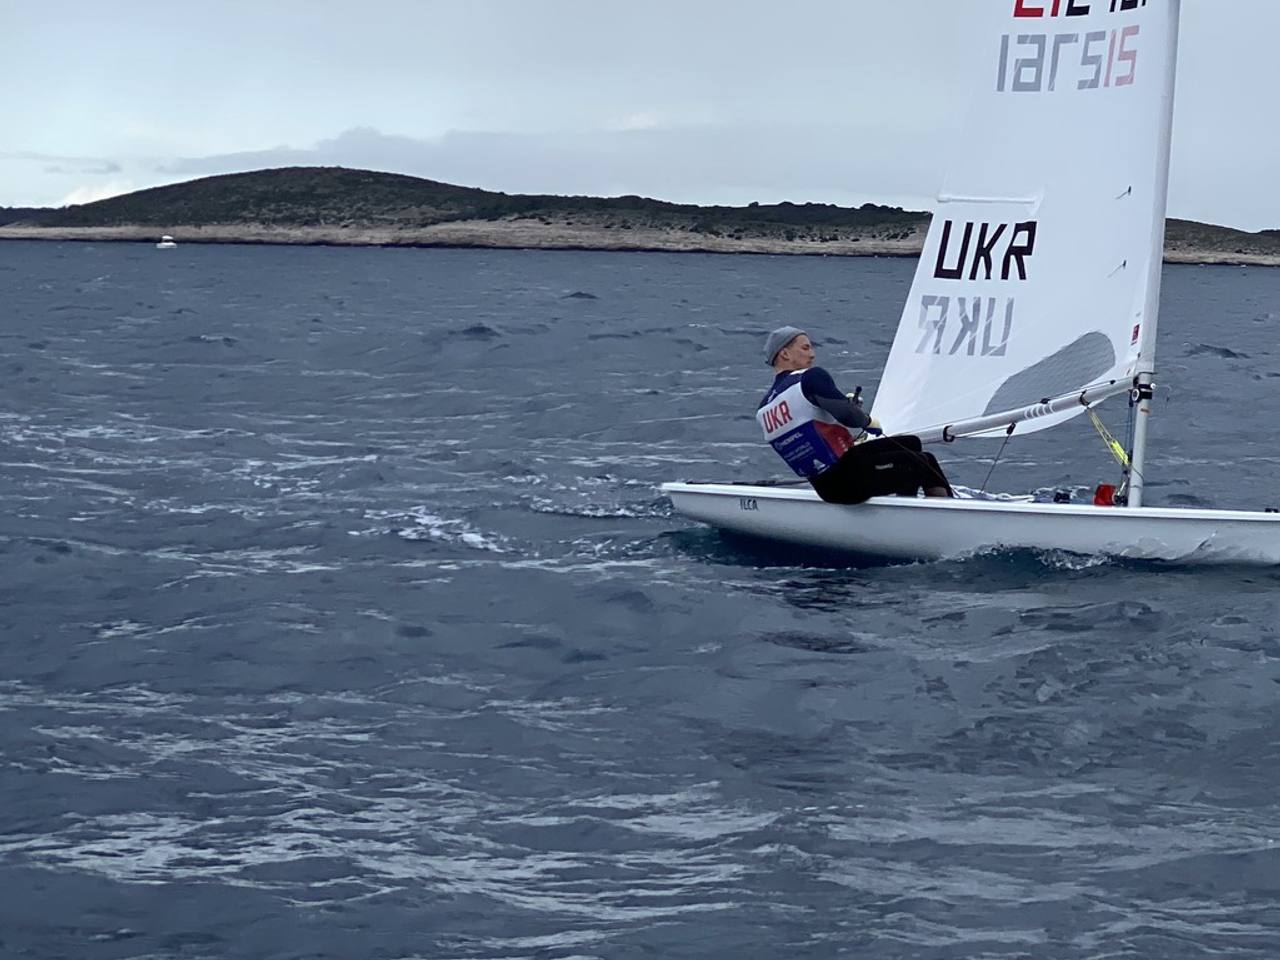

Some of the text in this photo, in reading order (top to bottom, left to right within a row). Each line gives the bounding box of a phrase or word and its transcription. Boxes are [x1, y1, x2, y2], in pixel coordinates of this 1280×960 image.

[934, 220, 1037, 280] UKR
[763, 400, 793, 433] UKR
[740, 499, 759, 511] ILCA
